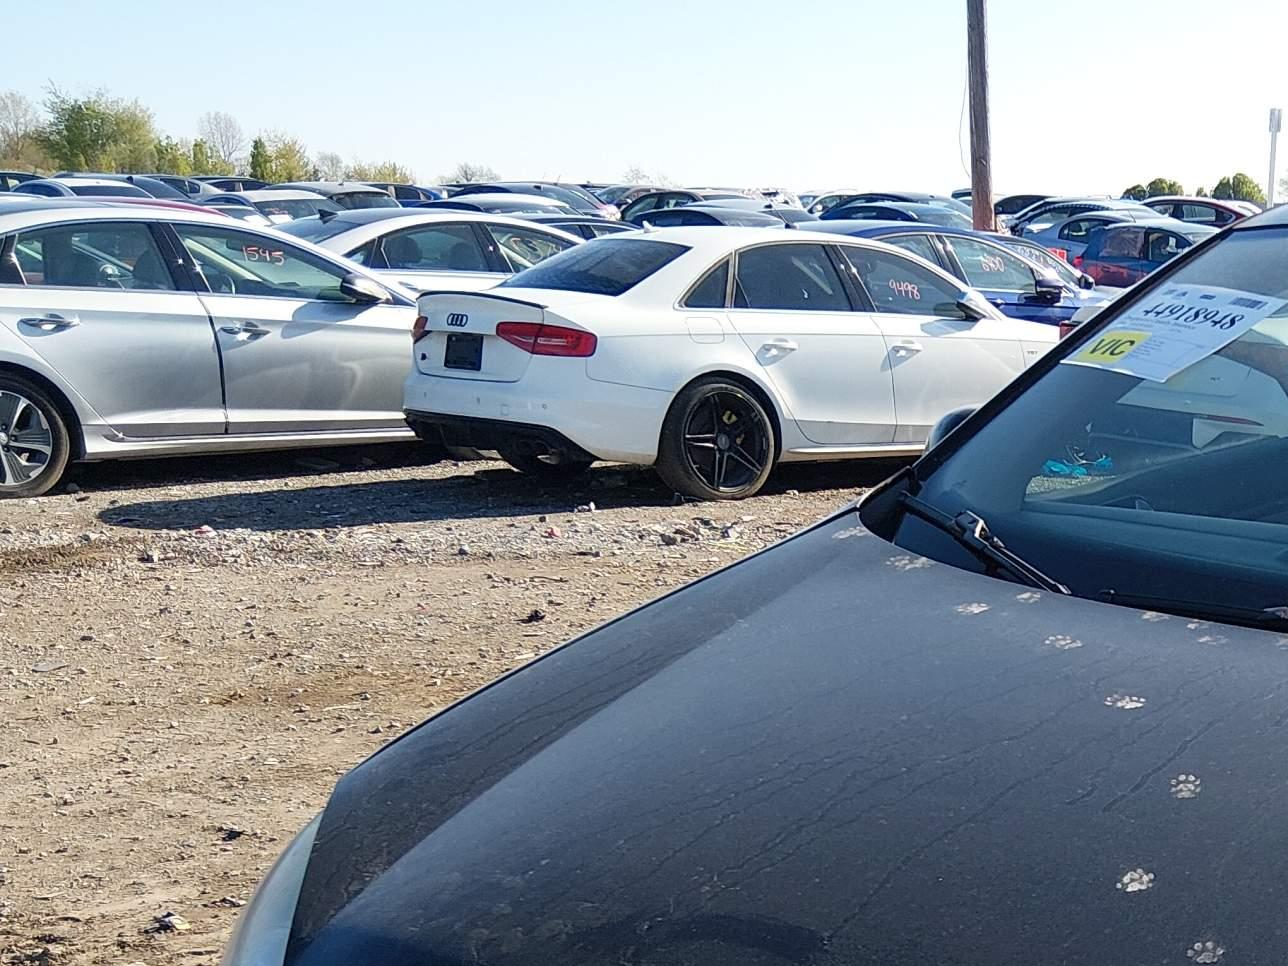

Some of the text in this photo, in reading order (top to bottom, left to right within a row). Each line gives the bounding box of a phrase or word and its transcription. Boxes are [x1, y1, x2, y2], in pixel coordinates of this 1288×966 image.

[242, 245, 285, 267] 1545
[889, 278, 921, 301] 9498
[1143, 302, 1245, 330] 44918948
[1089, 338, 1136, 356] VIC
